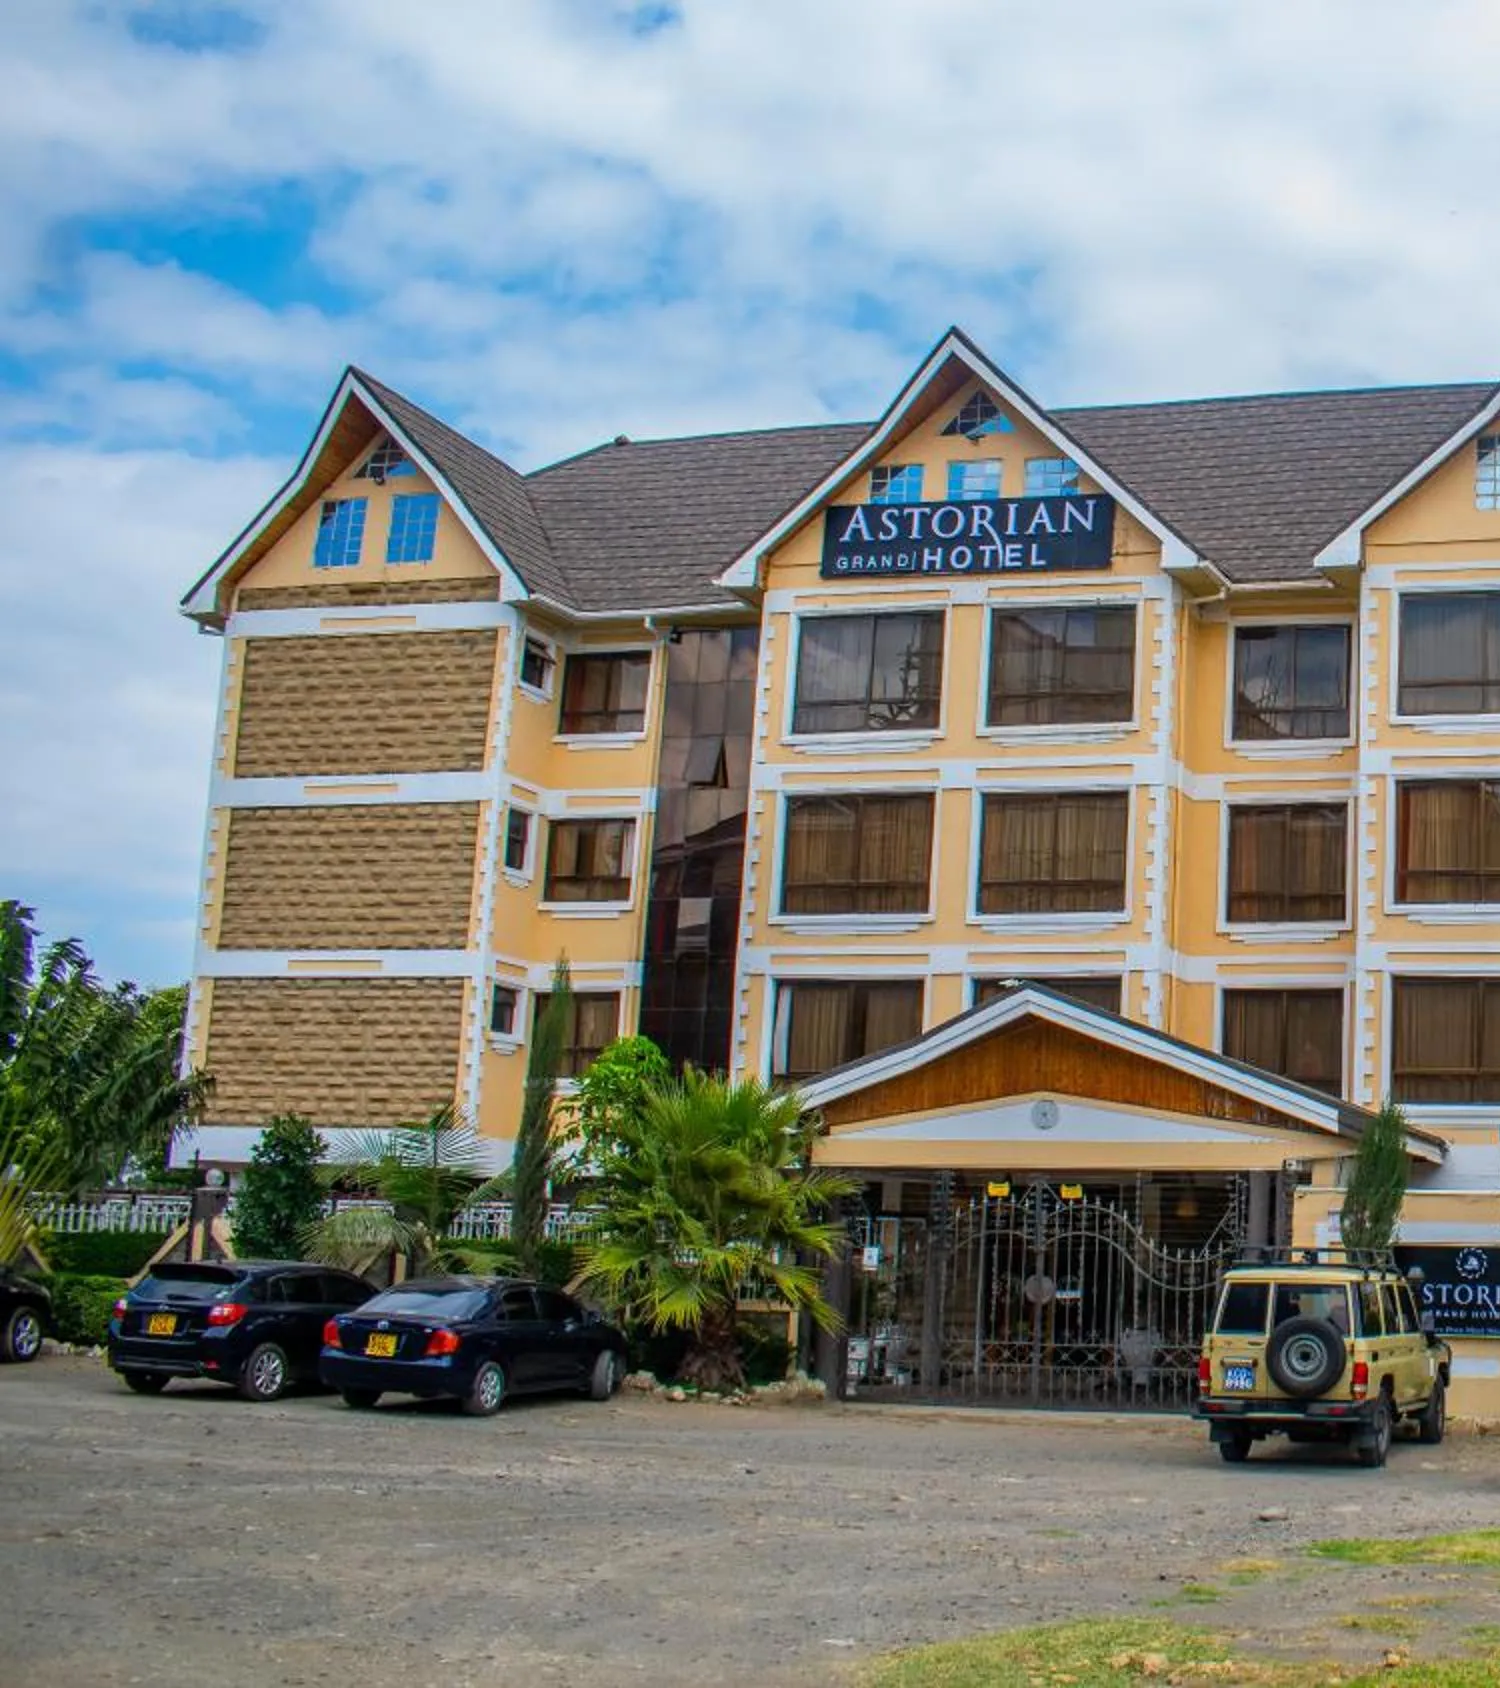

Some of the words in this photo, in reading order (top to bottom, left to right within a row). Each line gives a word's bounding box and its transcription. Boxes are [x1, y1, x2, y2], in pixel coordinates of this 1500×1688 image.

[839, 499, 1097, 544] ASTORIAN
[836, 551, 910, 570] GRAND
[922, 543, 1047, 571] HOTEL
